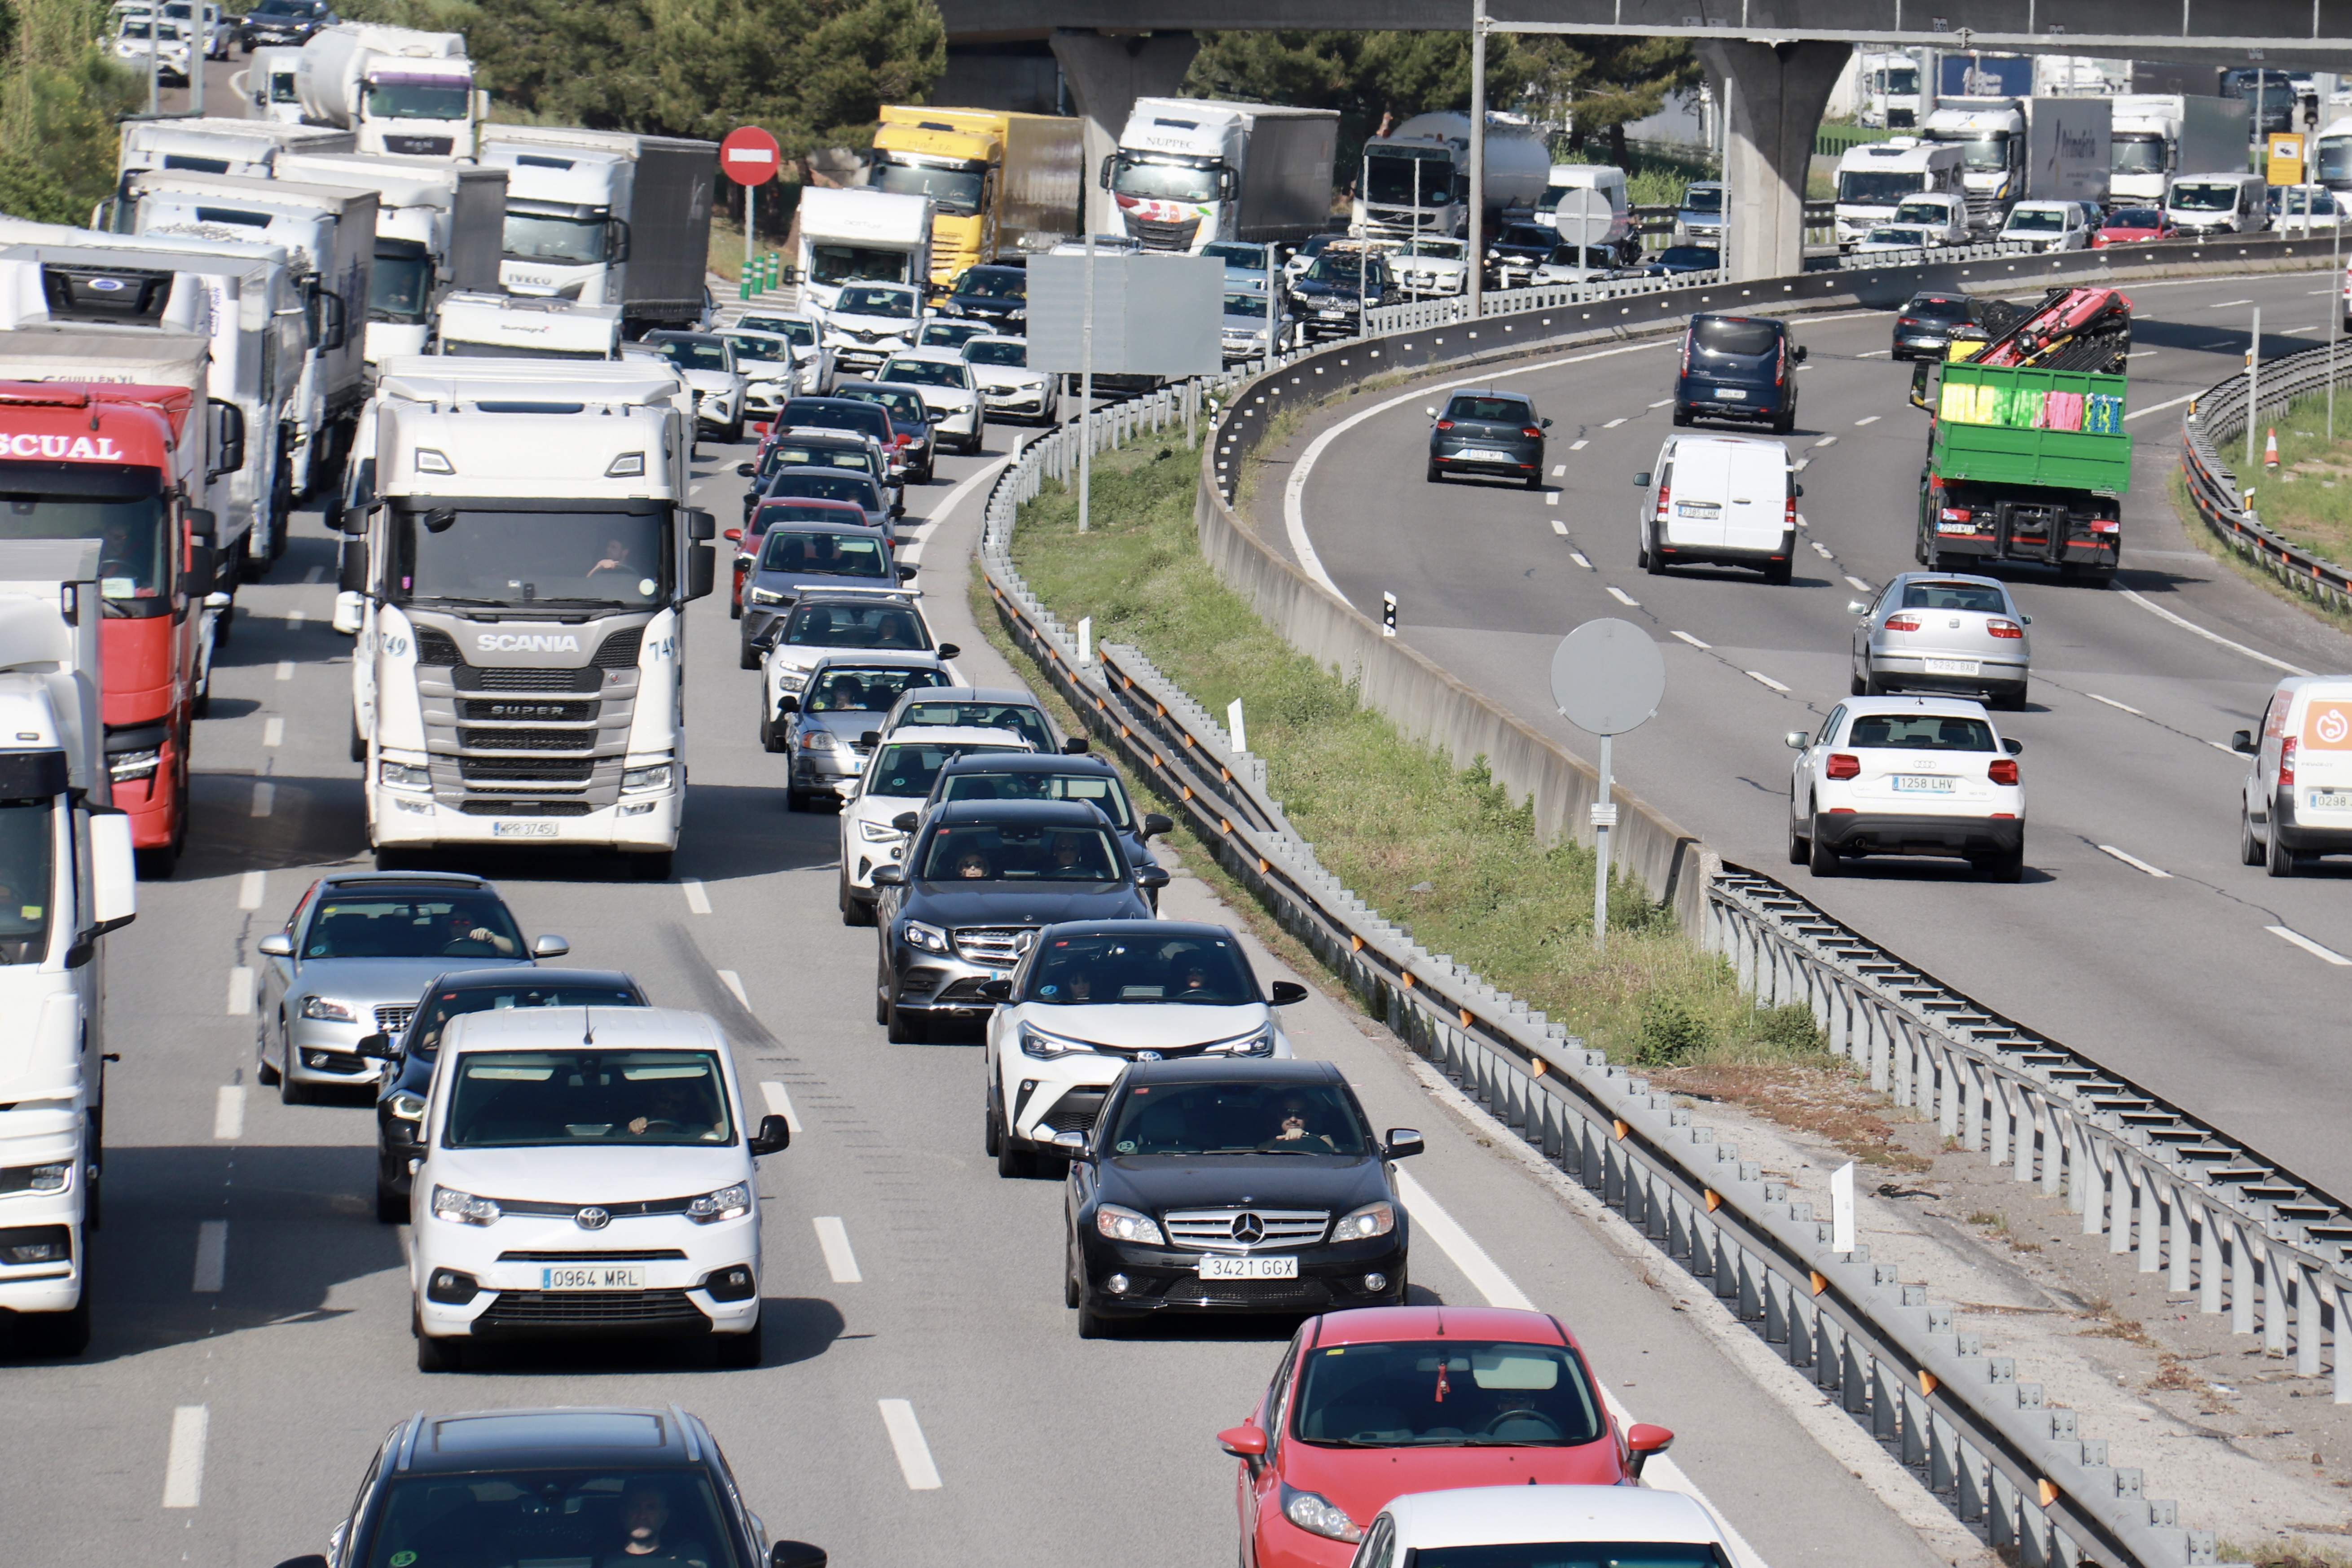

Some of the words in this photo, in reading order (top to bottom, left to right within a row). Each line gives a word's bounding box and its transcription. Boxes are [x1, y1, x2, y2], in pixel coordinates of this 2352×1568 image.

[1146, 136, 1195, 149] NUPPEC
[508, 273, 551, 285] IVECO
[476, 634, 579, 652] SCANIA
[1933, 661, 1955, 670] 5292
[1960, 662, 1976, 671] BXB
[491, 705, 564, 715] SUPER
[1902, 778, 1927, 788] 1258
[1932, 779, 1953, 789] LHV
[2318, 796, 2346, 806] 0298
[500, 823, 521, 835] WPR
[1213, 1261, 1253, 1275] 3421
[1262, 1260, 1293, 1275] GGX
[554, 1270, 597, 1287] 0964
[605, 1270, 638, 1286] MRL
